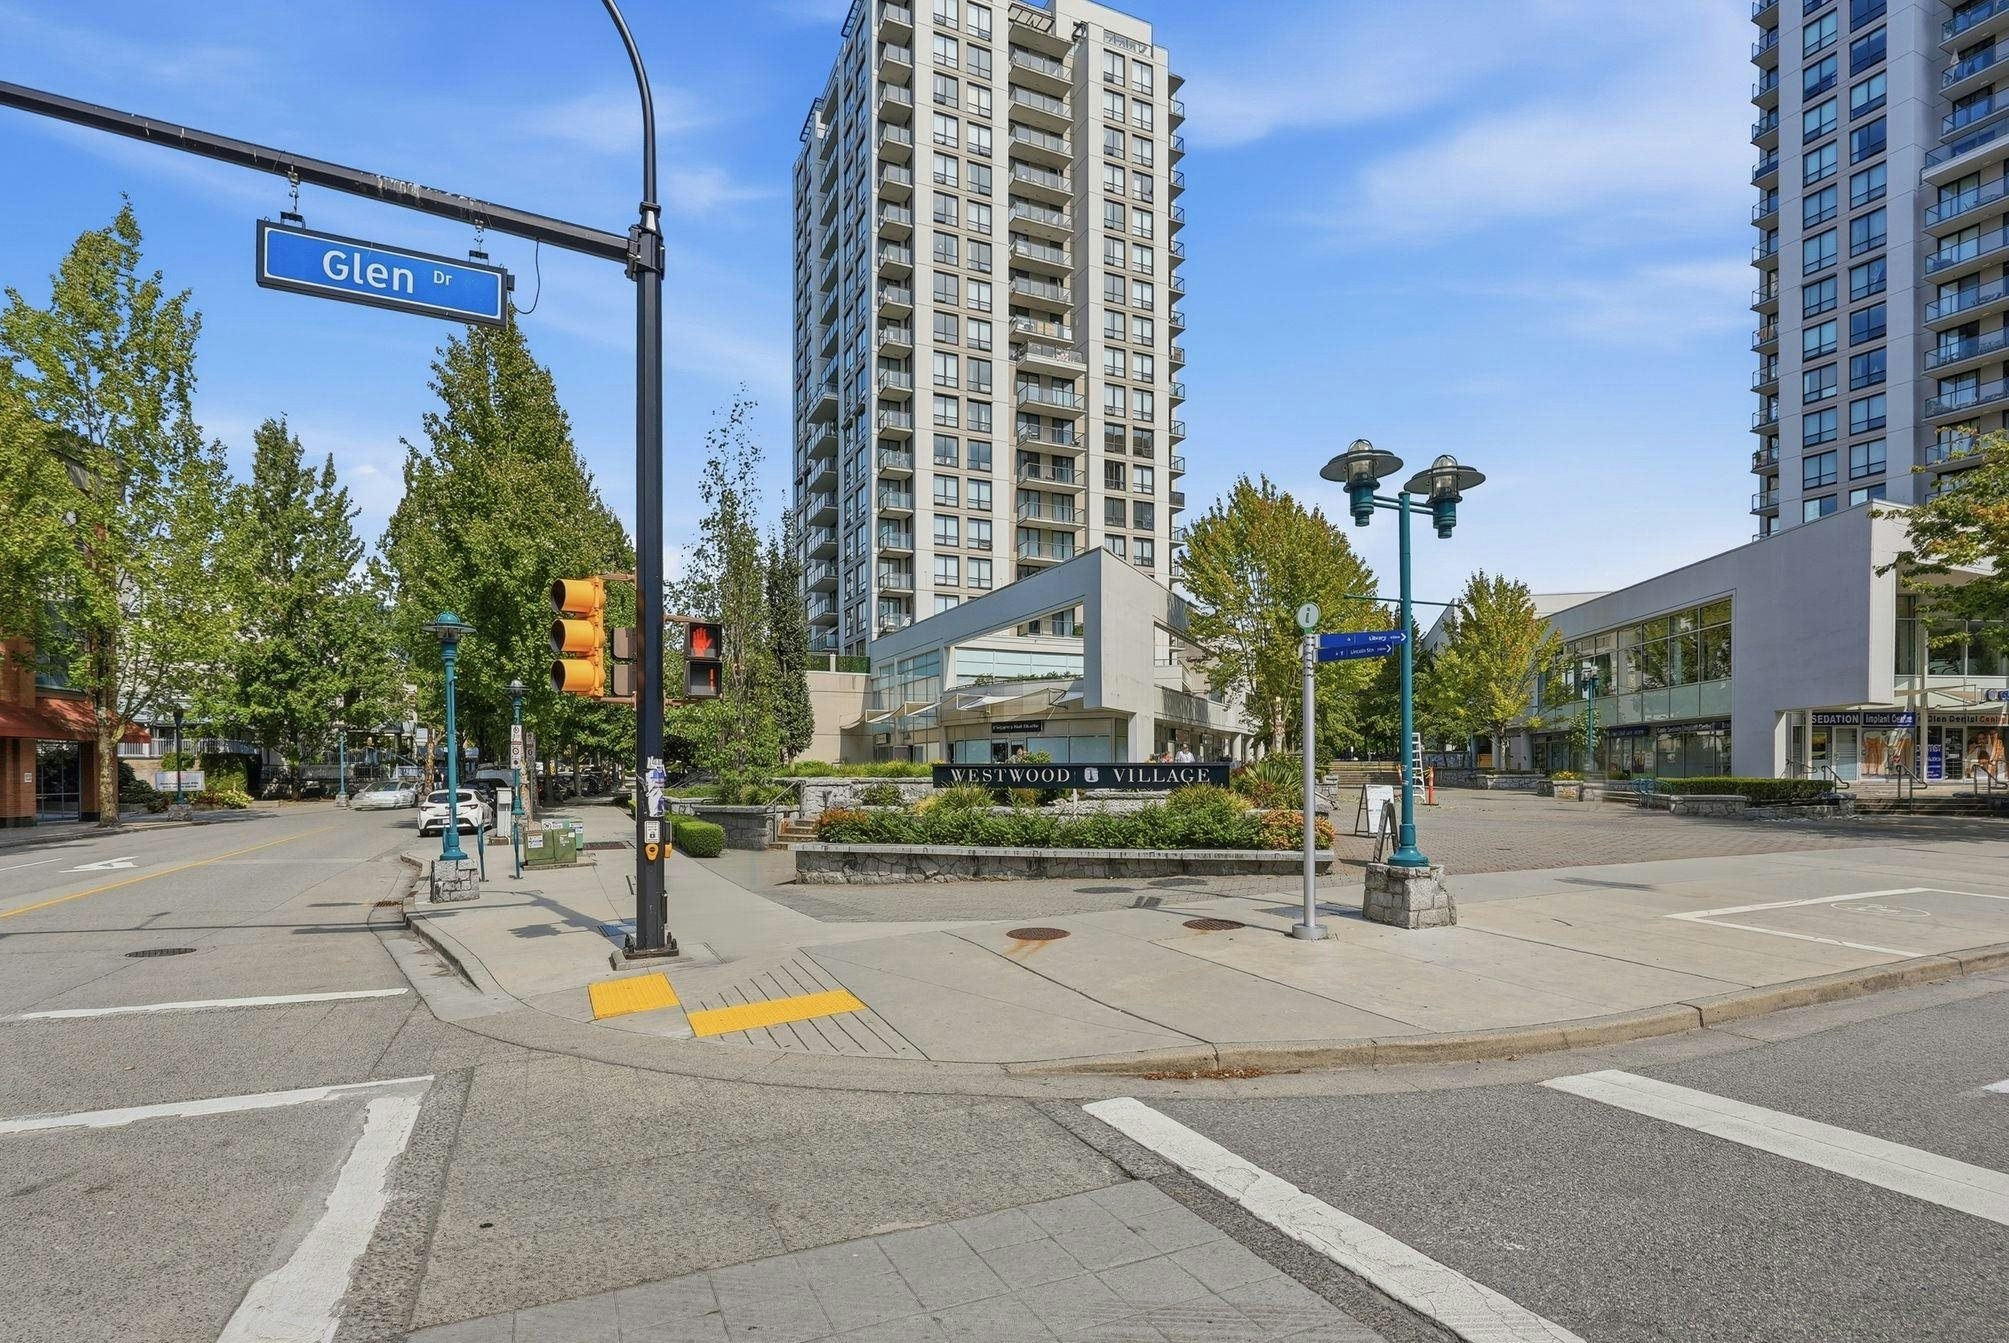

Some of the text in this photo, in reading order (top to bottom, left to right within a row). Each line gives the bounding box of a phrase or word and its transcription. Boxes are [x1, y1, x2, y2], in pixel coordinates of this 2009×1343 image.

[322, 250, 453, 294] Glen Dr
[1812, 714, 1859, 724] SEDATION
[1866, 714, 1890, 724] Implant
[1949, 715, 1978, 723] Dental
[950, 767, 1211, 784] WESTWOOD VILLAGE
